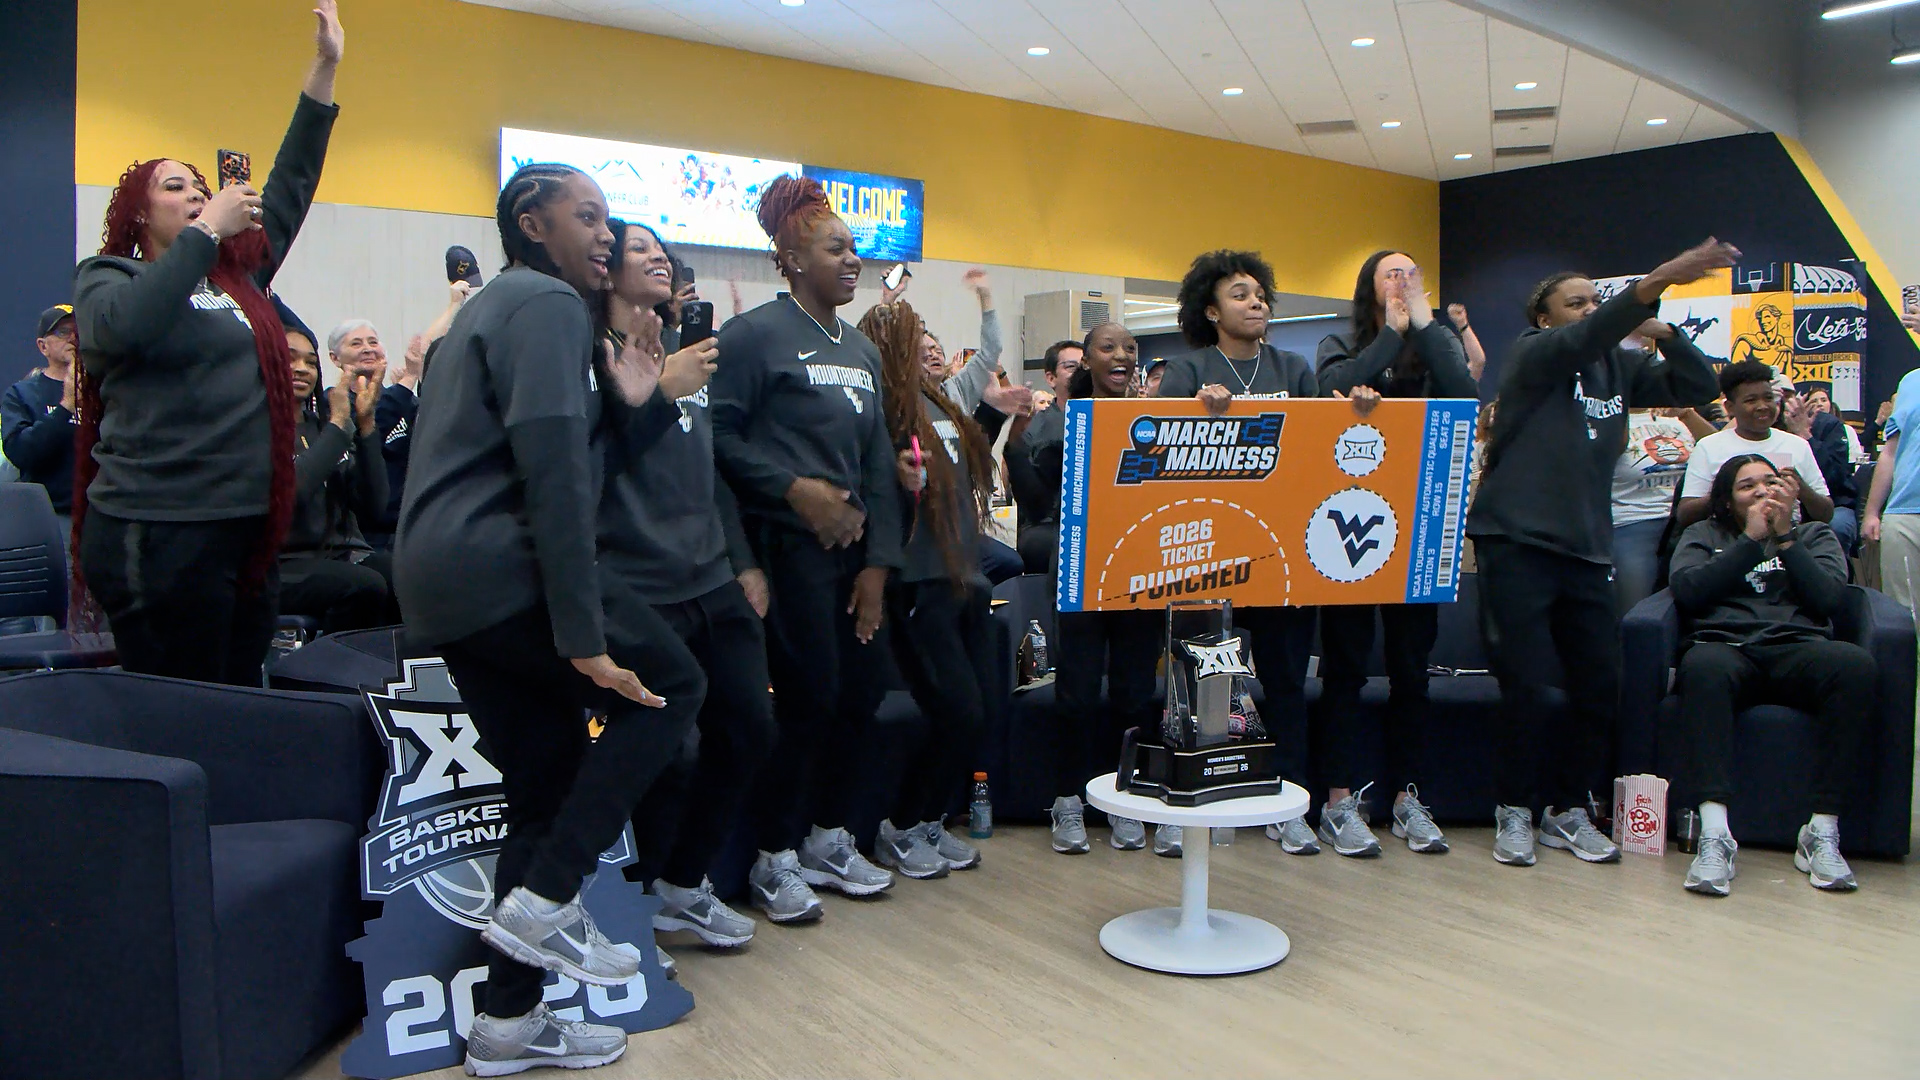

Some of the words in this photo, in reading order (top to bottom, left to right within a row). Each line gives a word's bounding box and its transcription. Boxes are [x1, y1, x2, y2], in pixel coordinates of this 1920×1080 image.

[822, 179, 908, 226] WELCOME
[1808, 316, 1851, 344] Let's
[805, 364, 876, 394] MOUNTAINEER
[1136, 430, 1157, 438] NCAA
[1156, 421, 1241, 446] MARCH
[1428, 410, 1440, 459] QUALIFIER
[1439, 426, 1449, 449] SEAT
[1072, 412, 1087, 516] @MARCHMADNESSWBB
[1165, 446, 1276, 471] MADNESS
[1422, 460, 1435, 512] AUTOMATIC
[1434, 482, 1443, 494] 15
[1432, 494, 1442, 517] ROW
[1159, 518, 1213, 548] 2026
[1415, 514, 1429, 573] TOURNAMENT
[1069, 525, 1082, 603] #MARCHMADNESS
[1161, 541, 1216, 567] TICKET
[1129, 556, 1251, 603] PUNCHED
[1412, 574, 1422, 598] NCAA
[1423, 556, 1435, 596] SECTION
[1187, 638, 1256, 680] XII
[1203, 767, 1212, 776] 20
[389, 803, 509, 852] BASKE
[1629, 809, 1650, 823] POP
[1631, 820, 1657, 834] CORN
[382, 823, 509, 874] TOURNA
